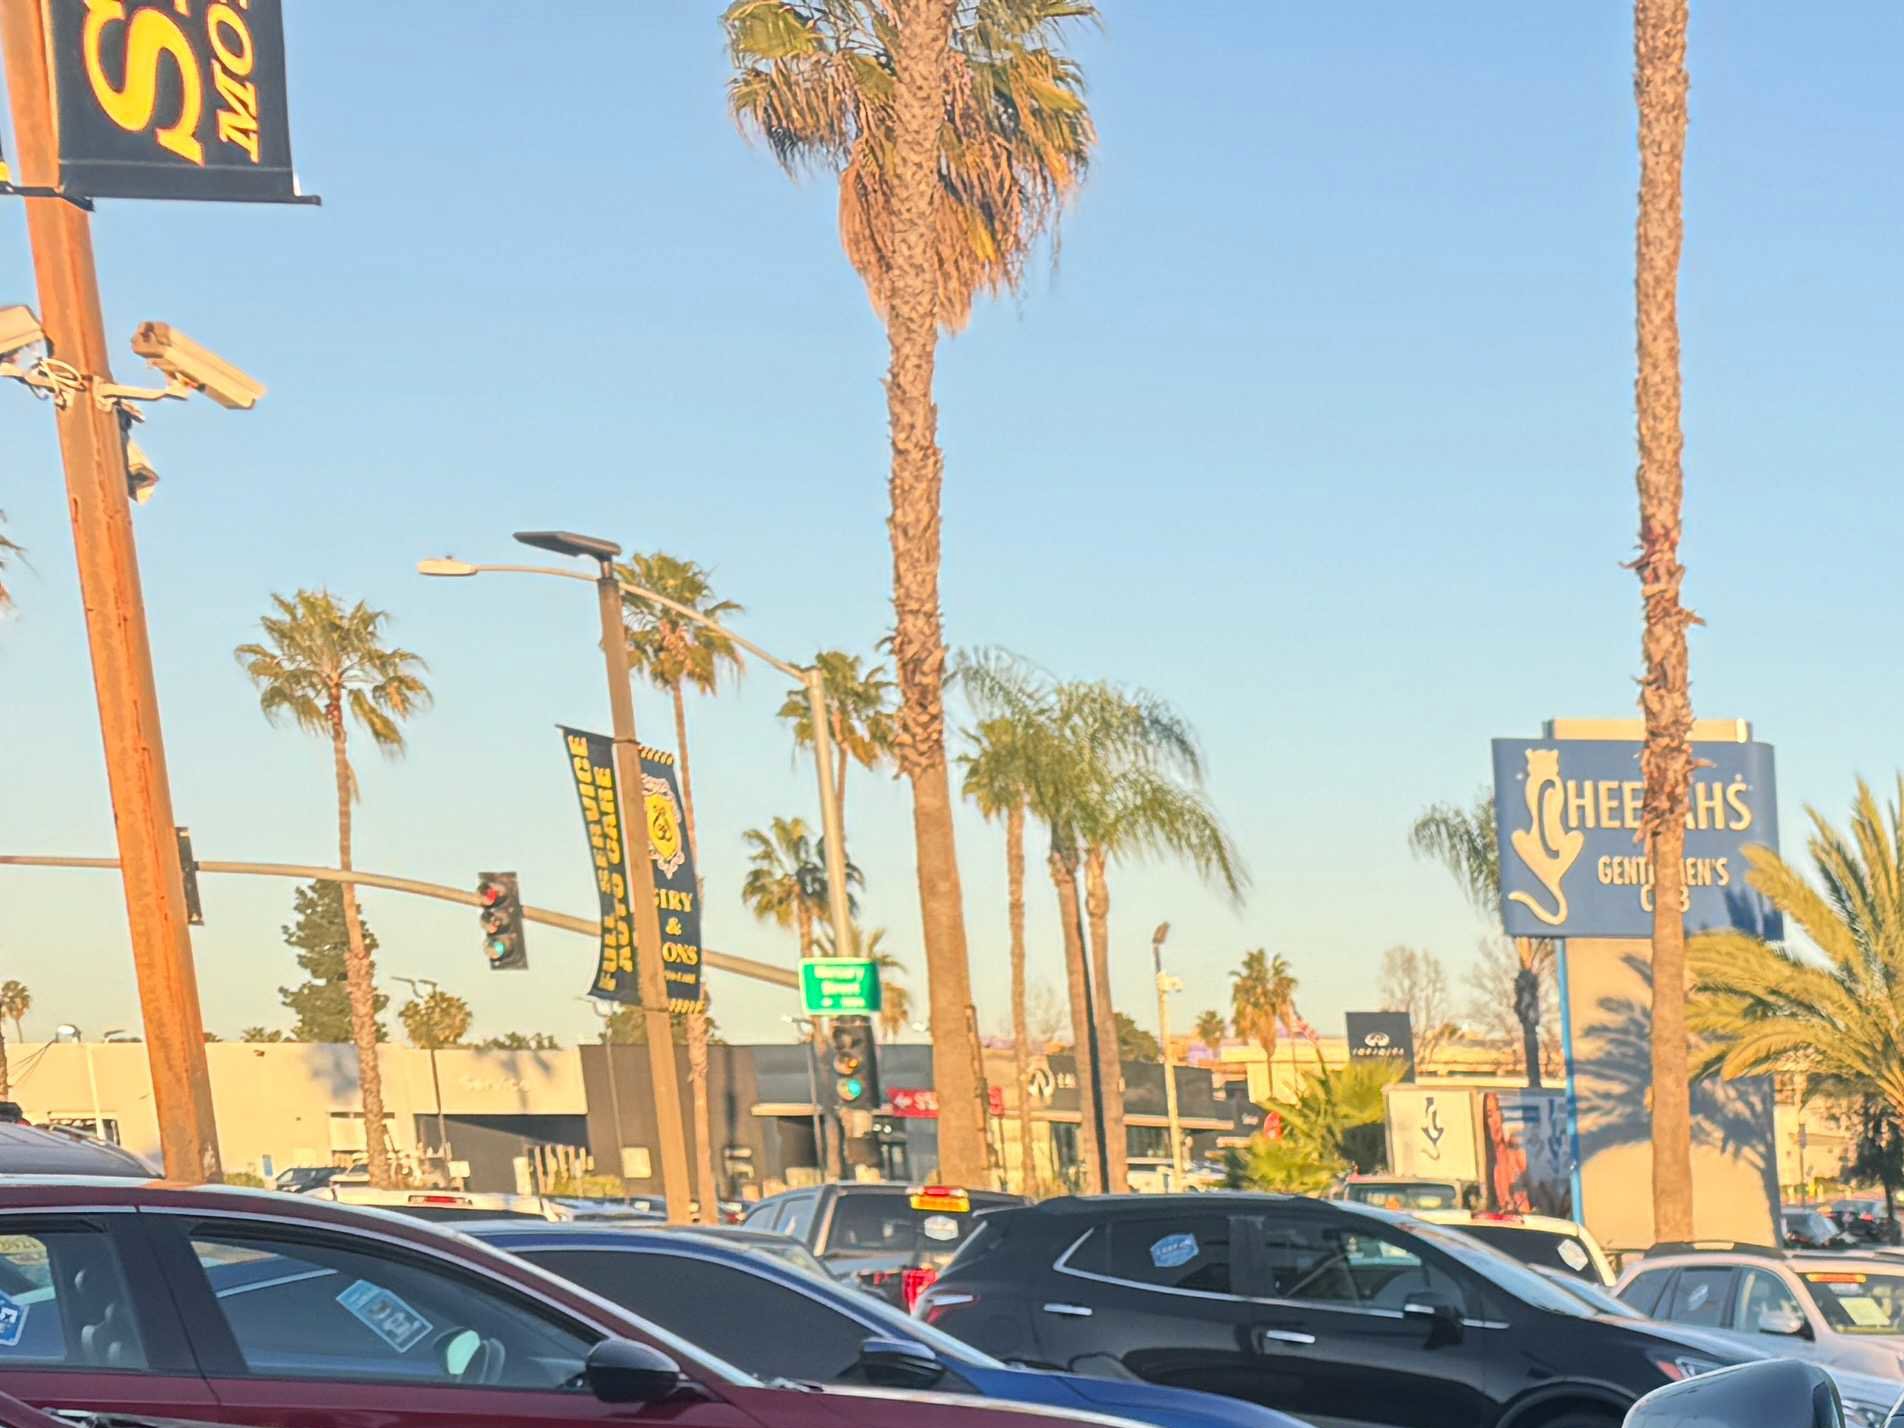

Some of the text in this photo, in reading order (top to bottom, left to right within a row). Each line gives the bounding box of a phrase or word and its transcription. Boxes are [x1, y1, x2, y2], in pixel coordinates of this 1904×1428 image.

[593, 766, 622, 865] CARE
[1598, 855, 1730, 886] GENTEN'S
[665, 917, 682, 935] &
[662, 942, 698, 965] ONS
